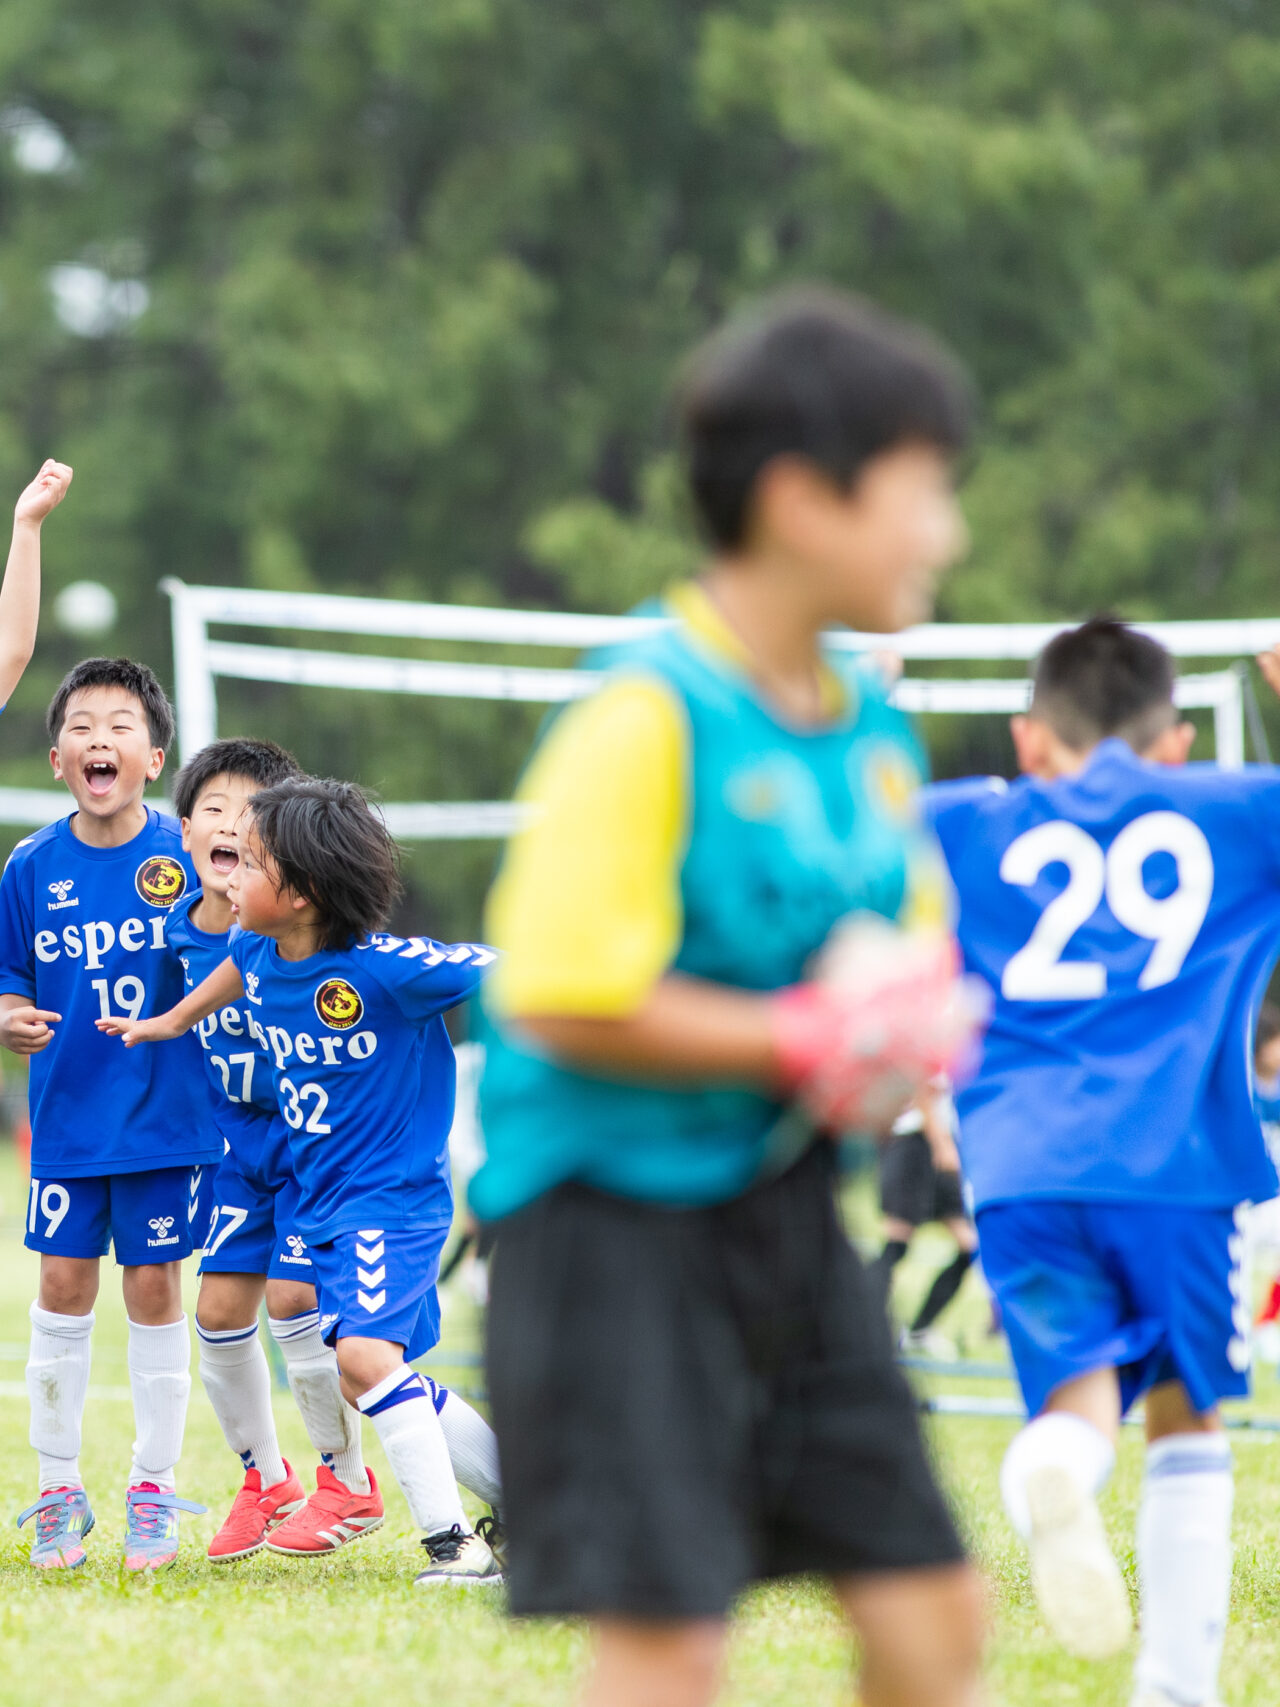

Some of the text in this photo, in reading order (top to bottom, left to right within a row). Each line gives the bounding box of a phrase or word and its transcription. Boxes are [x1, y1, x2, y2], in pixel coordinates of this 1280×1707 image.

[48, 897, 79, 911] hummel
[999, 809, 1215, 1001] 29
[34, 915, 168, 970] esper
[91, 975, 145, 1022] 19
[253, 1021, 377, 1070] spero
[210, 1052, 255, 1103] 27
[279, 1077, 331, 1134] 32
[29, 1178, 70, 1239] 19
[201, 1205, 248, 1257] 27
[147, 1234, 179, 1247] hummel
